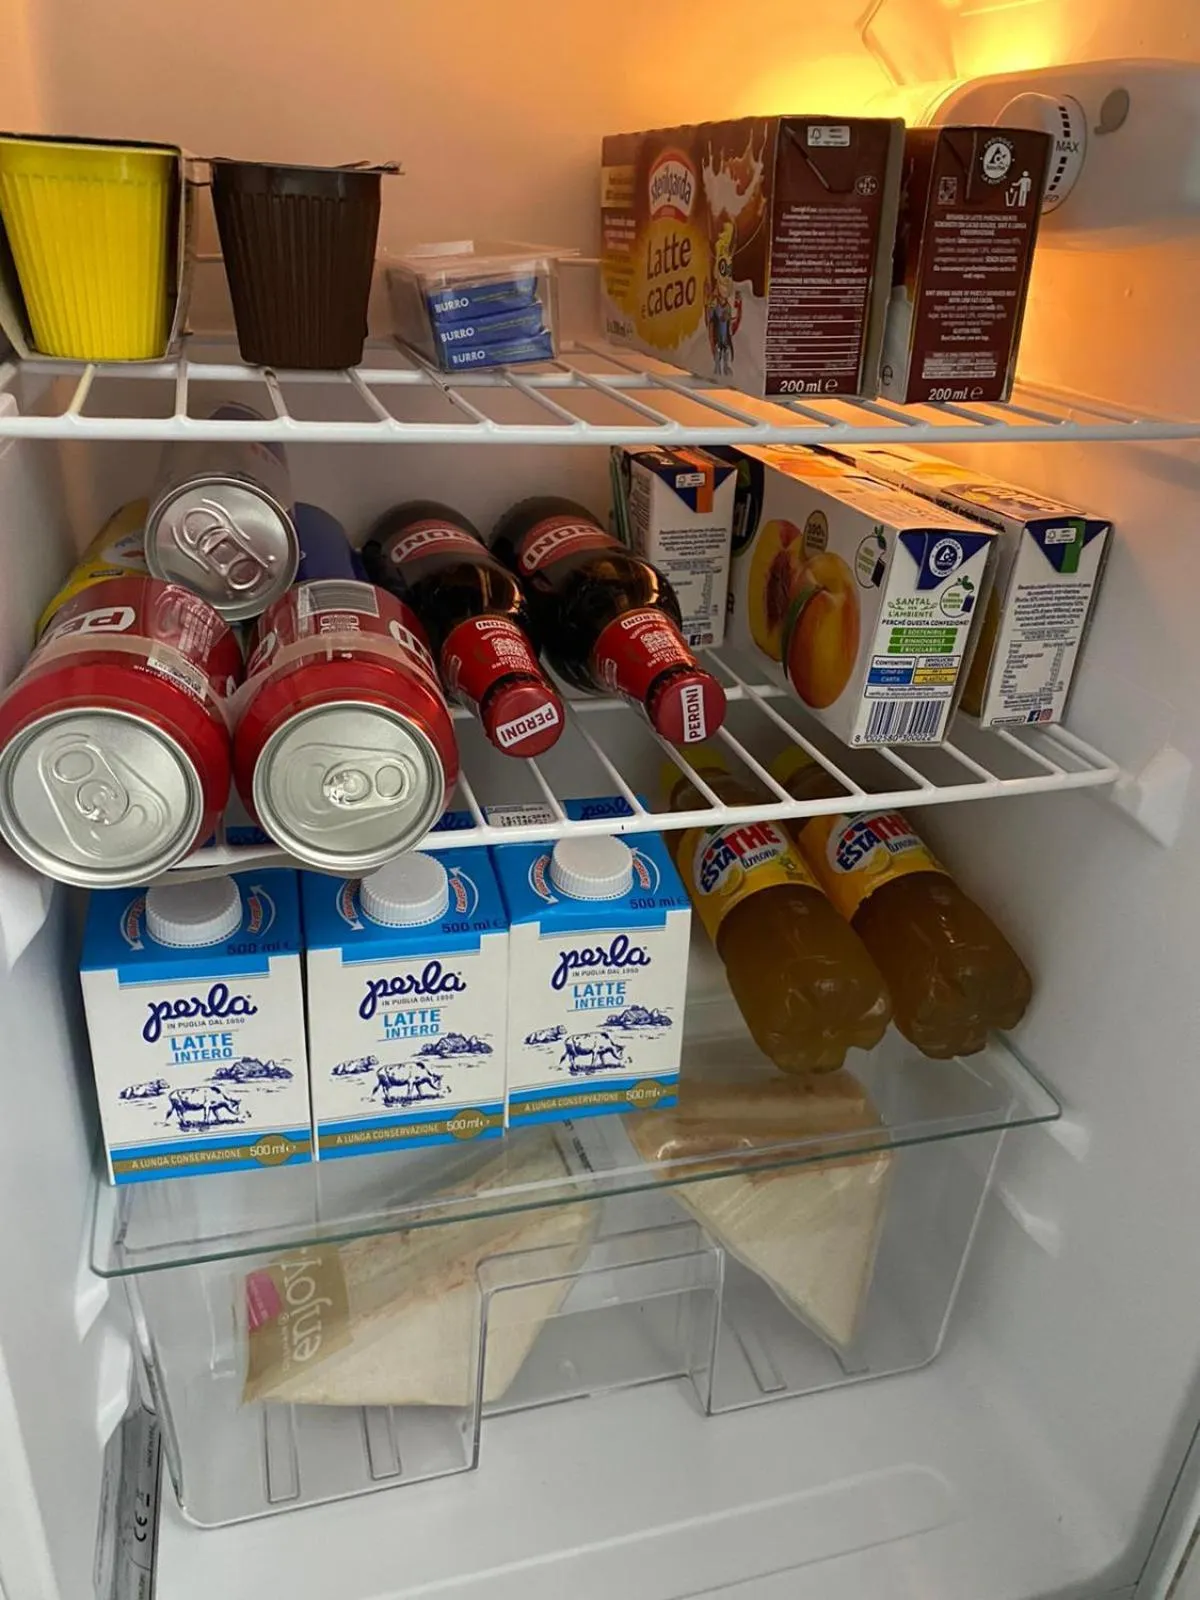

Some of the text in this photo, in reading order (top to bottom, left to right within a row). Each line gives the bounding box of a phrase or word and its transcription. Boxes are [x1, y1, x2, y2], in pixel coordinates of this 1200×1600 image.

[1056, 140, 1079, 152] MAX
[647, 232, 692, 280] Latte
[434, 297, 469, 314] BURRO
[647, 276, 696, 318] cacao
[440, 326, 475, 343] BURRO
[453, 350, 486, 364] BURRO
[780, 380, 804, 393] 200
[805, 380, 822, 393] ml
[928, 388, 951, 401] 200
[952, 387, 968, 400] ml
[525, 525, 600, 565] RONI
[896, 597, 931, 606] SANTAL
[686, 687, 700, 739] PERONI
[500, 706, 555, 743] PERONI
[630, 896, 675, 910] 500 ml
[442, 920, 490, 934] 500 ml
[551, 934, 651, 991] perla
[581, 968, 606, 977] PUGLIA
[358, 960, 467, 1021] perla
[573, 981, 626, 999] LATTE
[391, 996, 418, 1006] PUGLIA
[419, 995, 435, 1003] DAL
[575, 995, 625, 1010] INTERO
[142, 982, 258, 1043] perla
[383, 1009, 441, 1028] LATTE
[166, 1022, 176, 1030] IN
[178, 1020, 206, 1029] PUGLIA
[208, 1018, 225, 1026] DAL
[386, 1023, 440, 1040] INTERO
[171, 1032, 234, 1051] LATTE
[174, 1047, 233, 1063] INTERO
[524, 1088, 657, 1112] A LUNGA CONSERVAZIONE 500 ml
[336, 1118, 479, 1145] A LUNGA CONSERVAZIONE 500 ml
[131, 1144, 286, 1169] A LUNGA CONSERVAZIONE 500 ml
[280, 1256, 333, 1362] enjoy
